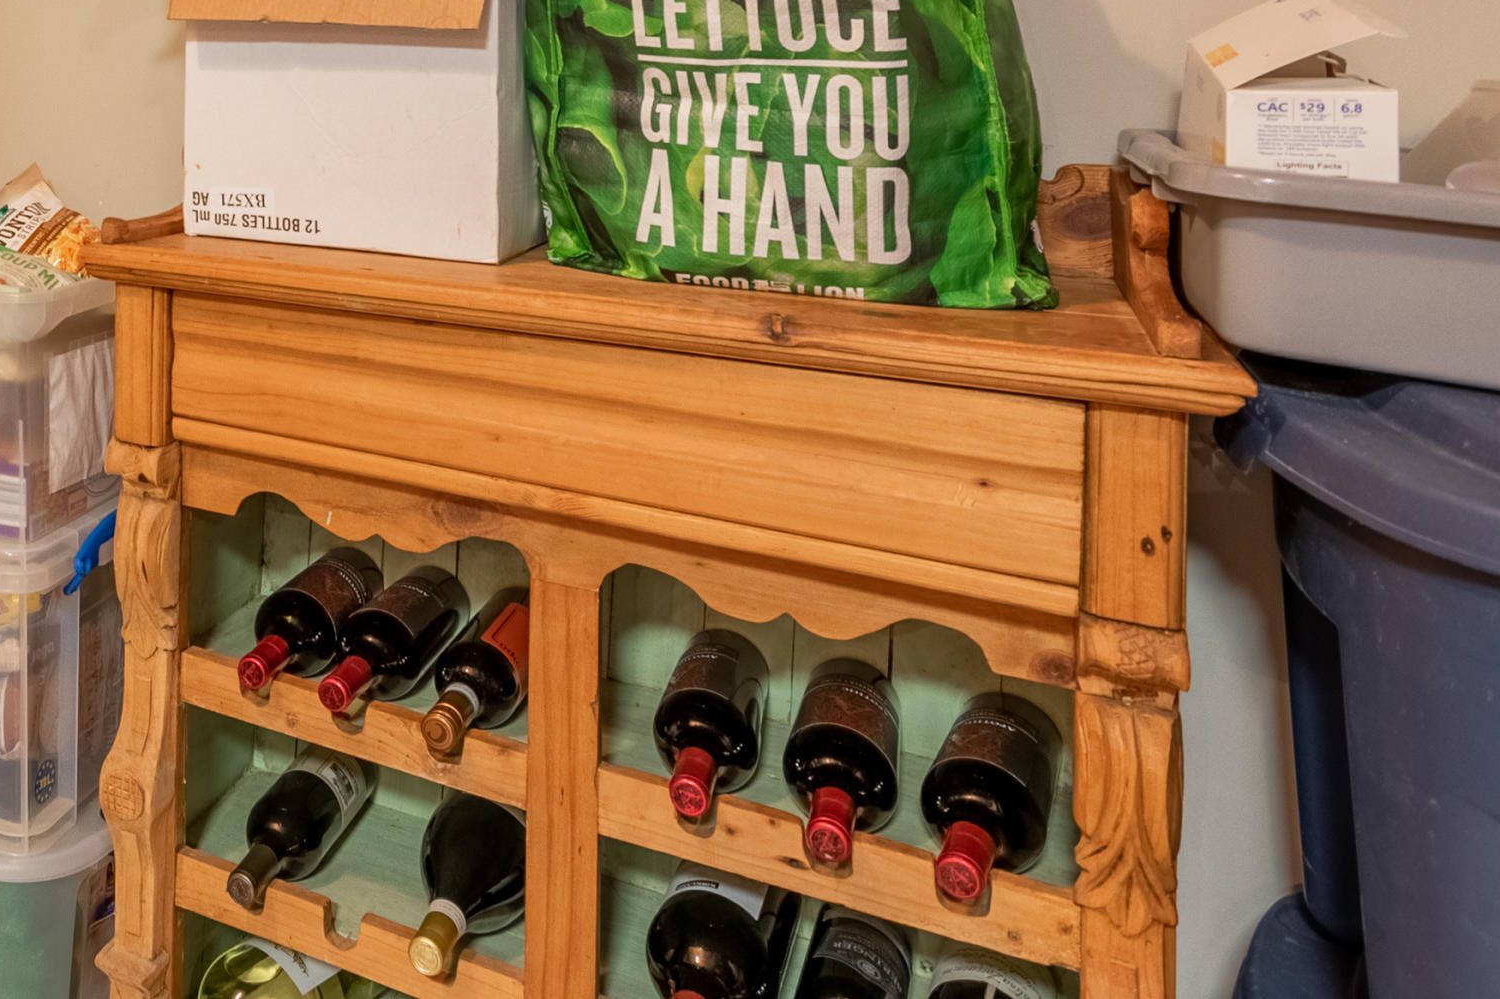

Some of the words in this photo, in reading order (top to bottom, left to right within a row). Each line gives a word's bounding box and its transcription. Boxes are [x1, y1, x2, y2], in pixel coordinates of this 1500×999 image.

[640, 65, 762, 153] GIVE
[782, 69, 911, 165] YOU
[1257, 102, 1289, 113] CAC
[1300, 102, 1326, 113] $29
[1341, 103, 1363, 113] 6.8
[1276, 161, 1315, 170] Lighting
[1317, 162, 1342, 170] Facts
[192, 191, 210, 206] AG
[220, 192, 267, 208] BX571
[635, 147, 676, 249] A
[700, 153, 913, 268] HAND
[191, 209, 210, 223] mL
[241, 213, 300, 232] BOTTLES
[304, 219, 321, 234] 12
[37, 269, 60, 290] MI
